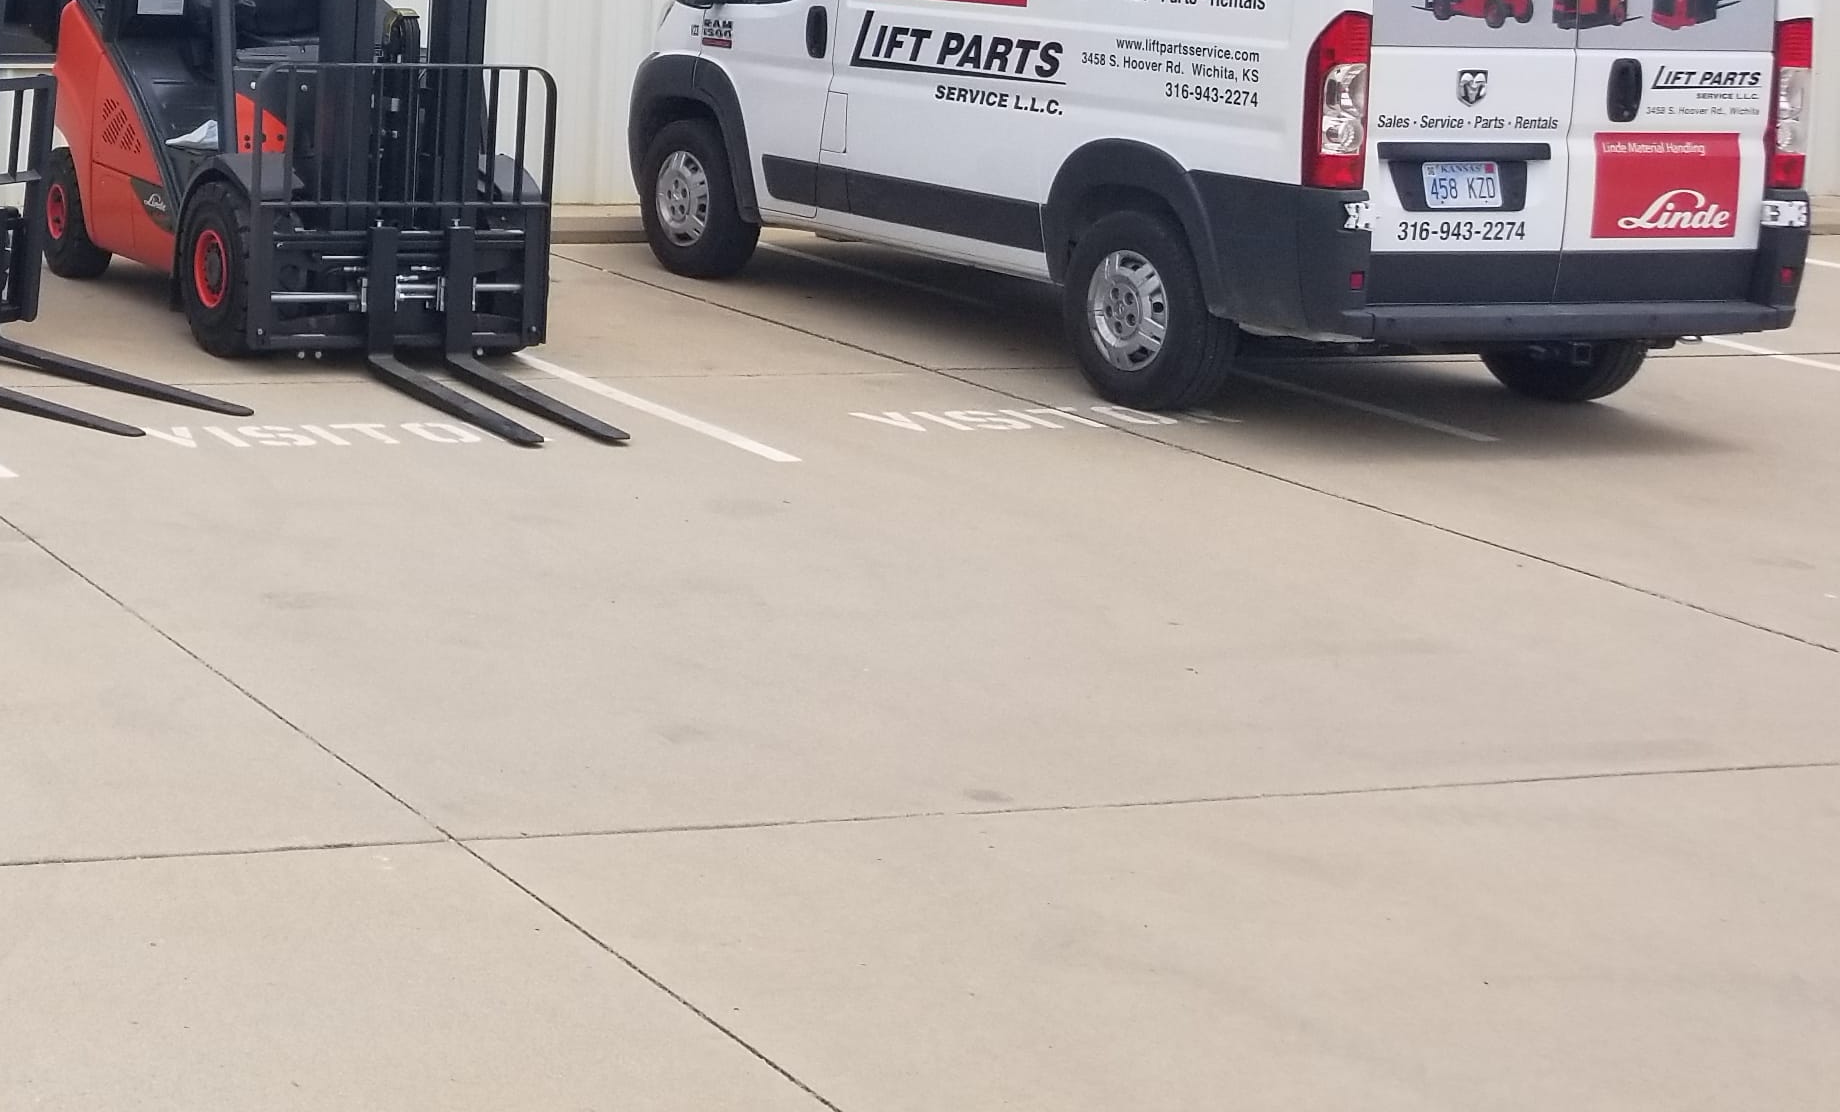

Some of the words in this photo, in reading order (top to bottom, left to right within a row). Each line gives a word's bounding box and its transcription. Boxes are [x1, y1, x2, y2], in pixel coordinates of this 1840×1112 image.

[849, 10, 933, 67] LIFT
[936, 31, 1064, 78] PARTS
[1116, 38, 1260, 63] www.liftpartsservice.com
[1081, 52, 1106, 66] 3458
[1109, 54, 1120, 67] S.
[1123, 56, 1162, 72] Hoover
[1165, 61, 1185, 75] Rd.
[1191, 63, 1238, 82] Wichita,
[1242, 68, 1259, 83] KS
[1651, 65, 1696, 90] LIFT
[1699, 71, 1761, 86] PARTS
[935, 85, 1009, 108] SERVICE
[1014, 95, 1064, 116] L.L.C.
[1165, 82, 1259, 108] 316-943-2274
[1696, 92, 1733, 100] SERVICE
[1377, 114, 1410, 129] Sales
[1420, 114, 1464, 129] Service
[1474, 115, 1505, 129] Parts
[1514, 115, 1558, 130] Rentals
[1646, 106, 1666, 115] 3458
[1678, 106, 1708, 115] Hoover
[1729, 107, 1760, 115] Wichita
[1602, 141, 1627, 153] Linde
[1628, 142, 1665, 154] Material
[1666, 142, 1706, 156] Handling
[1440, 164, 1482, 174] KANSAS
[1430, 177, 1458, 200] 458
[1467, 177, 1496, 199] KZD
[143, 193, 167, 212] Linde
[1617, 189, 1730, 229] Linde
[1397, 221, 1526, 241] 316-943-2274
[143, 422, 554, 449] VISITO
